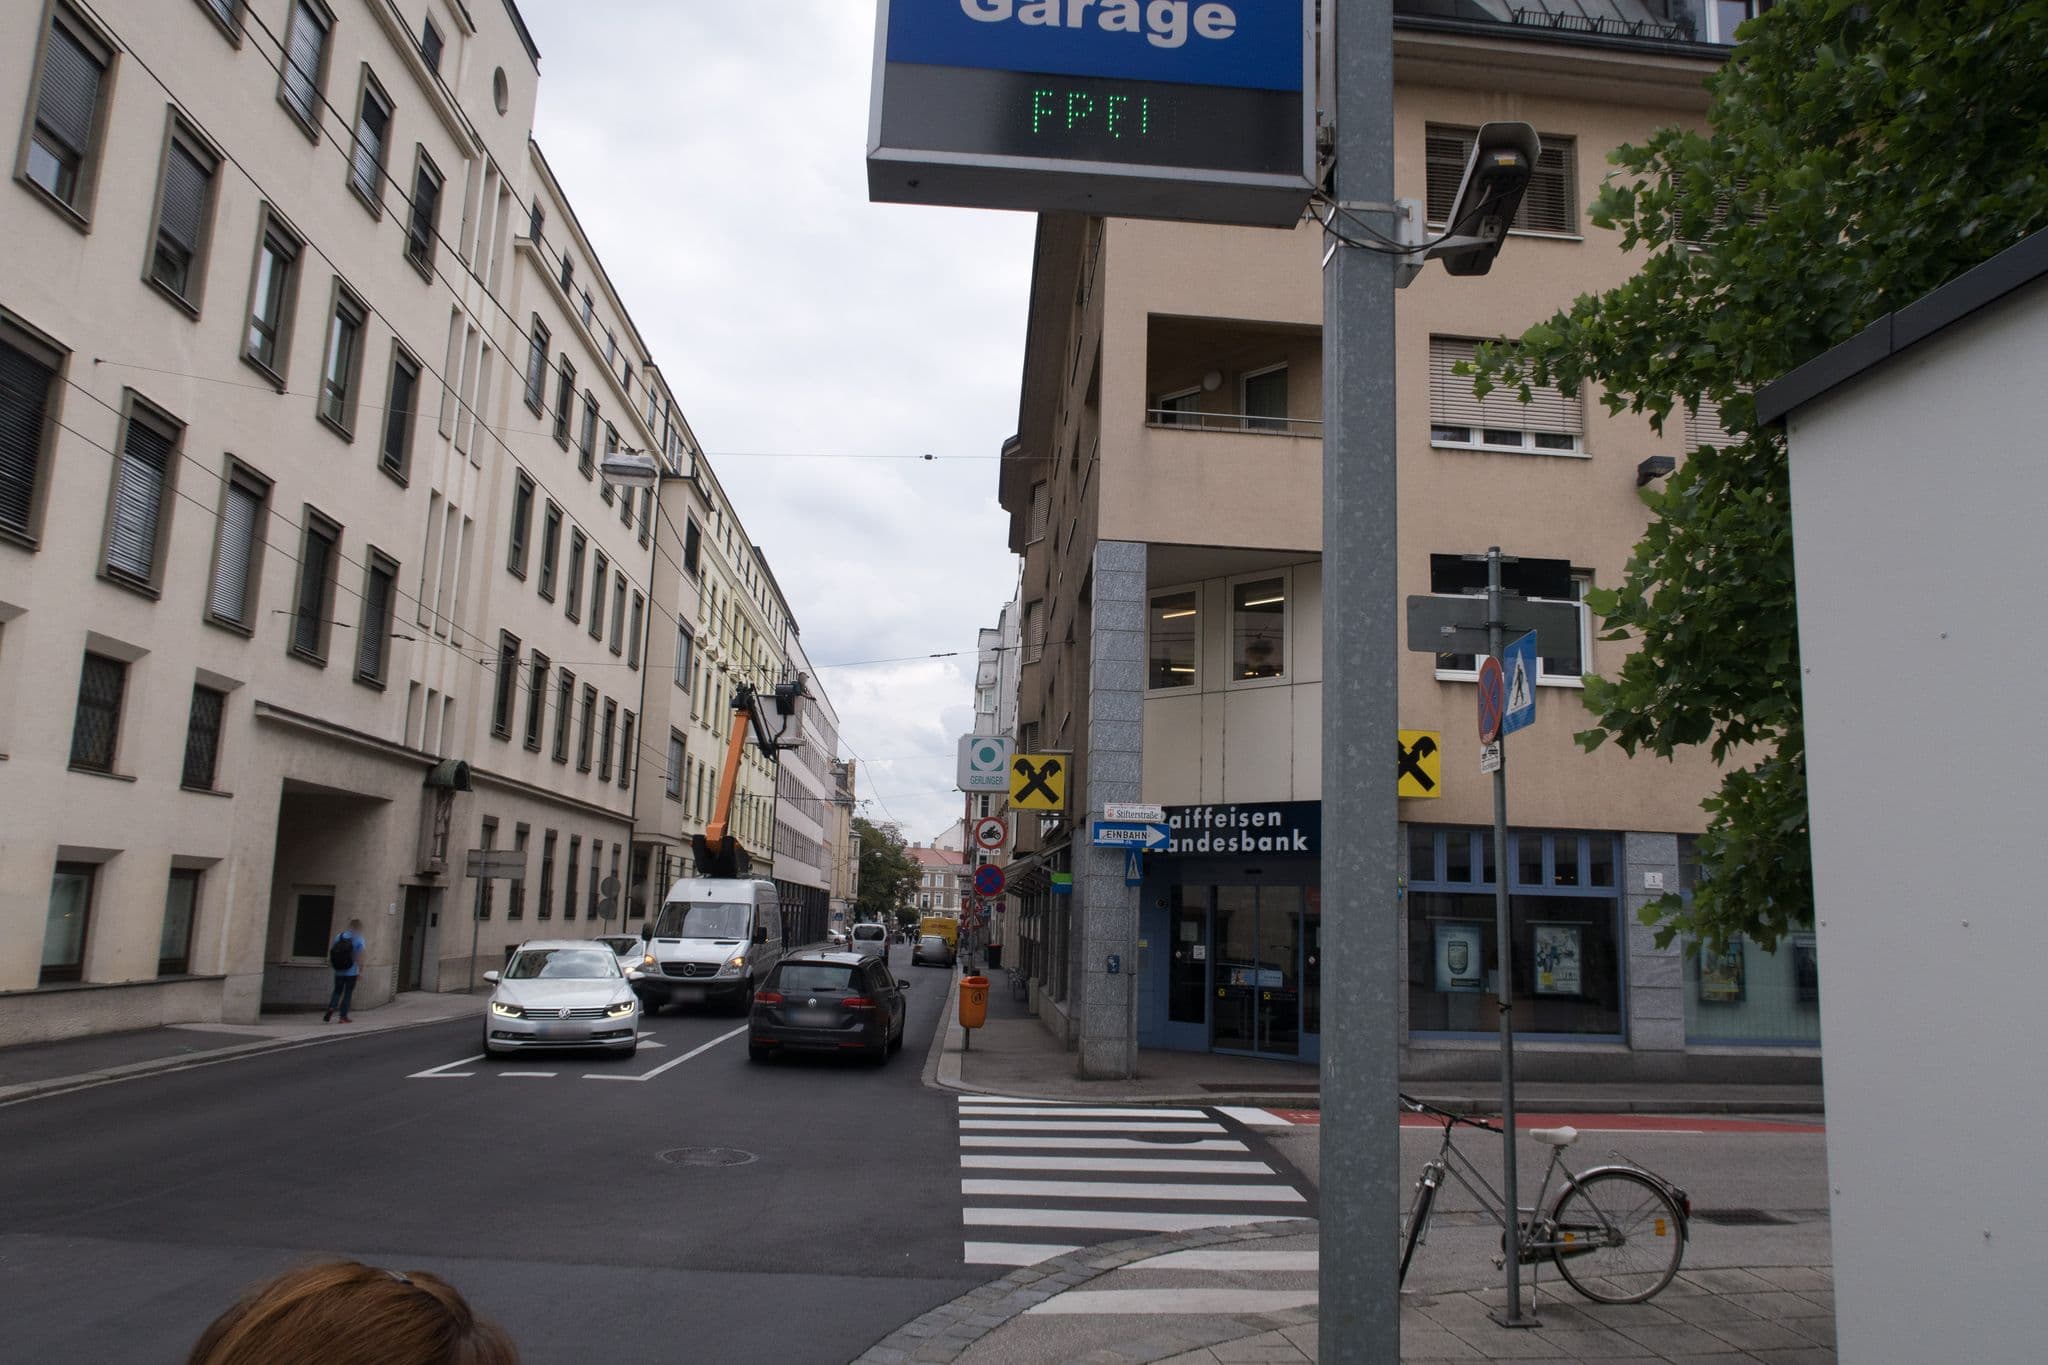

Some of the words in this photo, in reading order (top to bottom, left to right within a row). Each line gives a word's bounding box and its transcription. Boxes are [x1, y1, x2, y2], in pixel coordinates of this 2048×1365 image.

[970, 775, 1004, 785] GERLINGER
[1117, 809, 1159, 820] Stifterstraße
[1106, 830, 1148, 840] EINBAHN
[1154, 828, 1308, 853] andesbank
